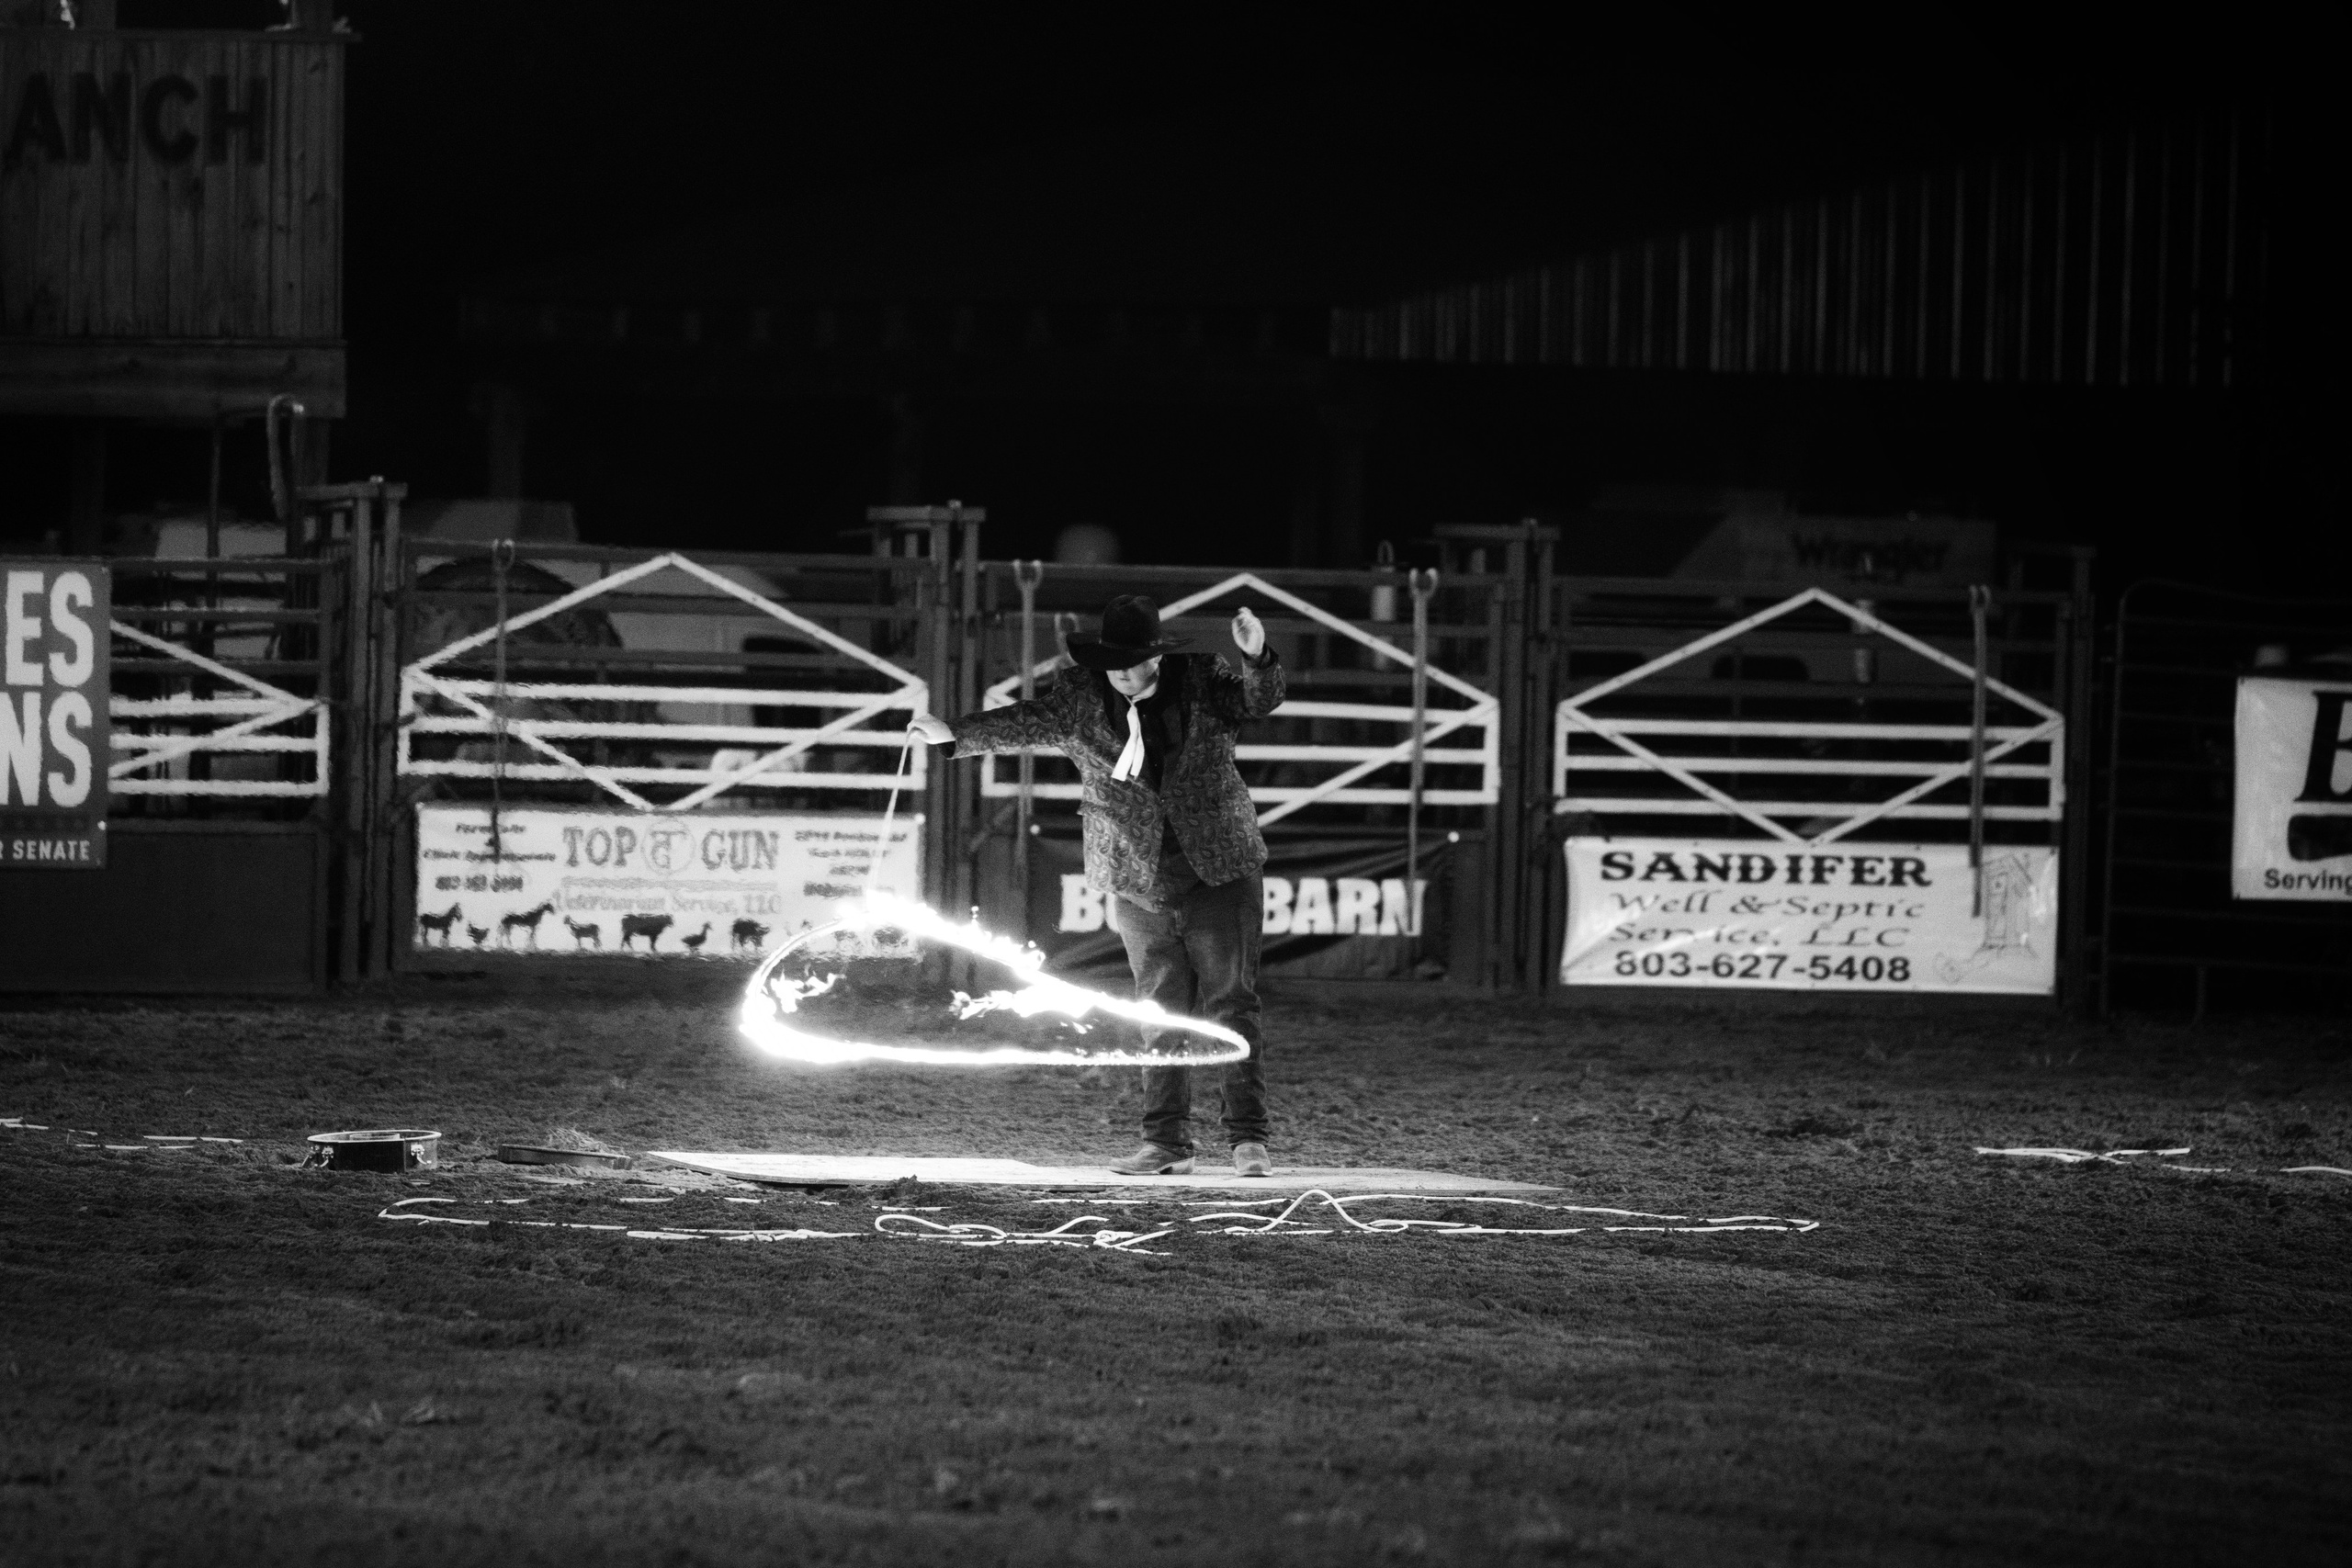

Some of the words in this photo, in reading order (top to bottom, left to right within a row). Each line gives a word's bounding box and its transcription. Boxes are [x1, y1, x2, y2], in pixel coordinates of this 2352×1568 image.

[6, 570, 94, 688] ES
[13, 840, 90, 861] SENATE
[562, 826, 637, 867] TOP
[701, 829, 780, 871] GUN
[1600, 851, 1933, 887] SANDIFER
[2264, 868, 2352, 896] Serving
[1262, 875, 1428, 936] BARN
[1610, 889, 1724, 914] Well
[1730, 895, 1781, 915] &
[1780, 895, 1924, 922] Septic
[1610, 922, 1781, 946] Serice,
[1799, 920, 1910, 948] LLC
[1615, 950, 1910, 982] 803-627-5408
